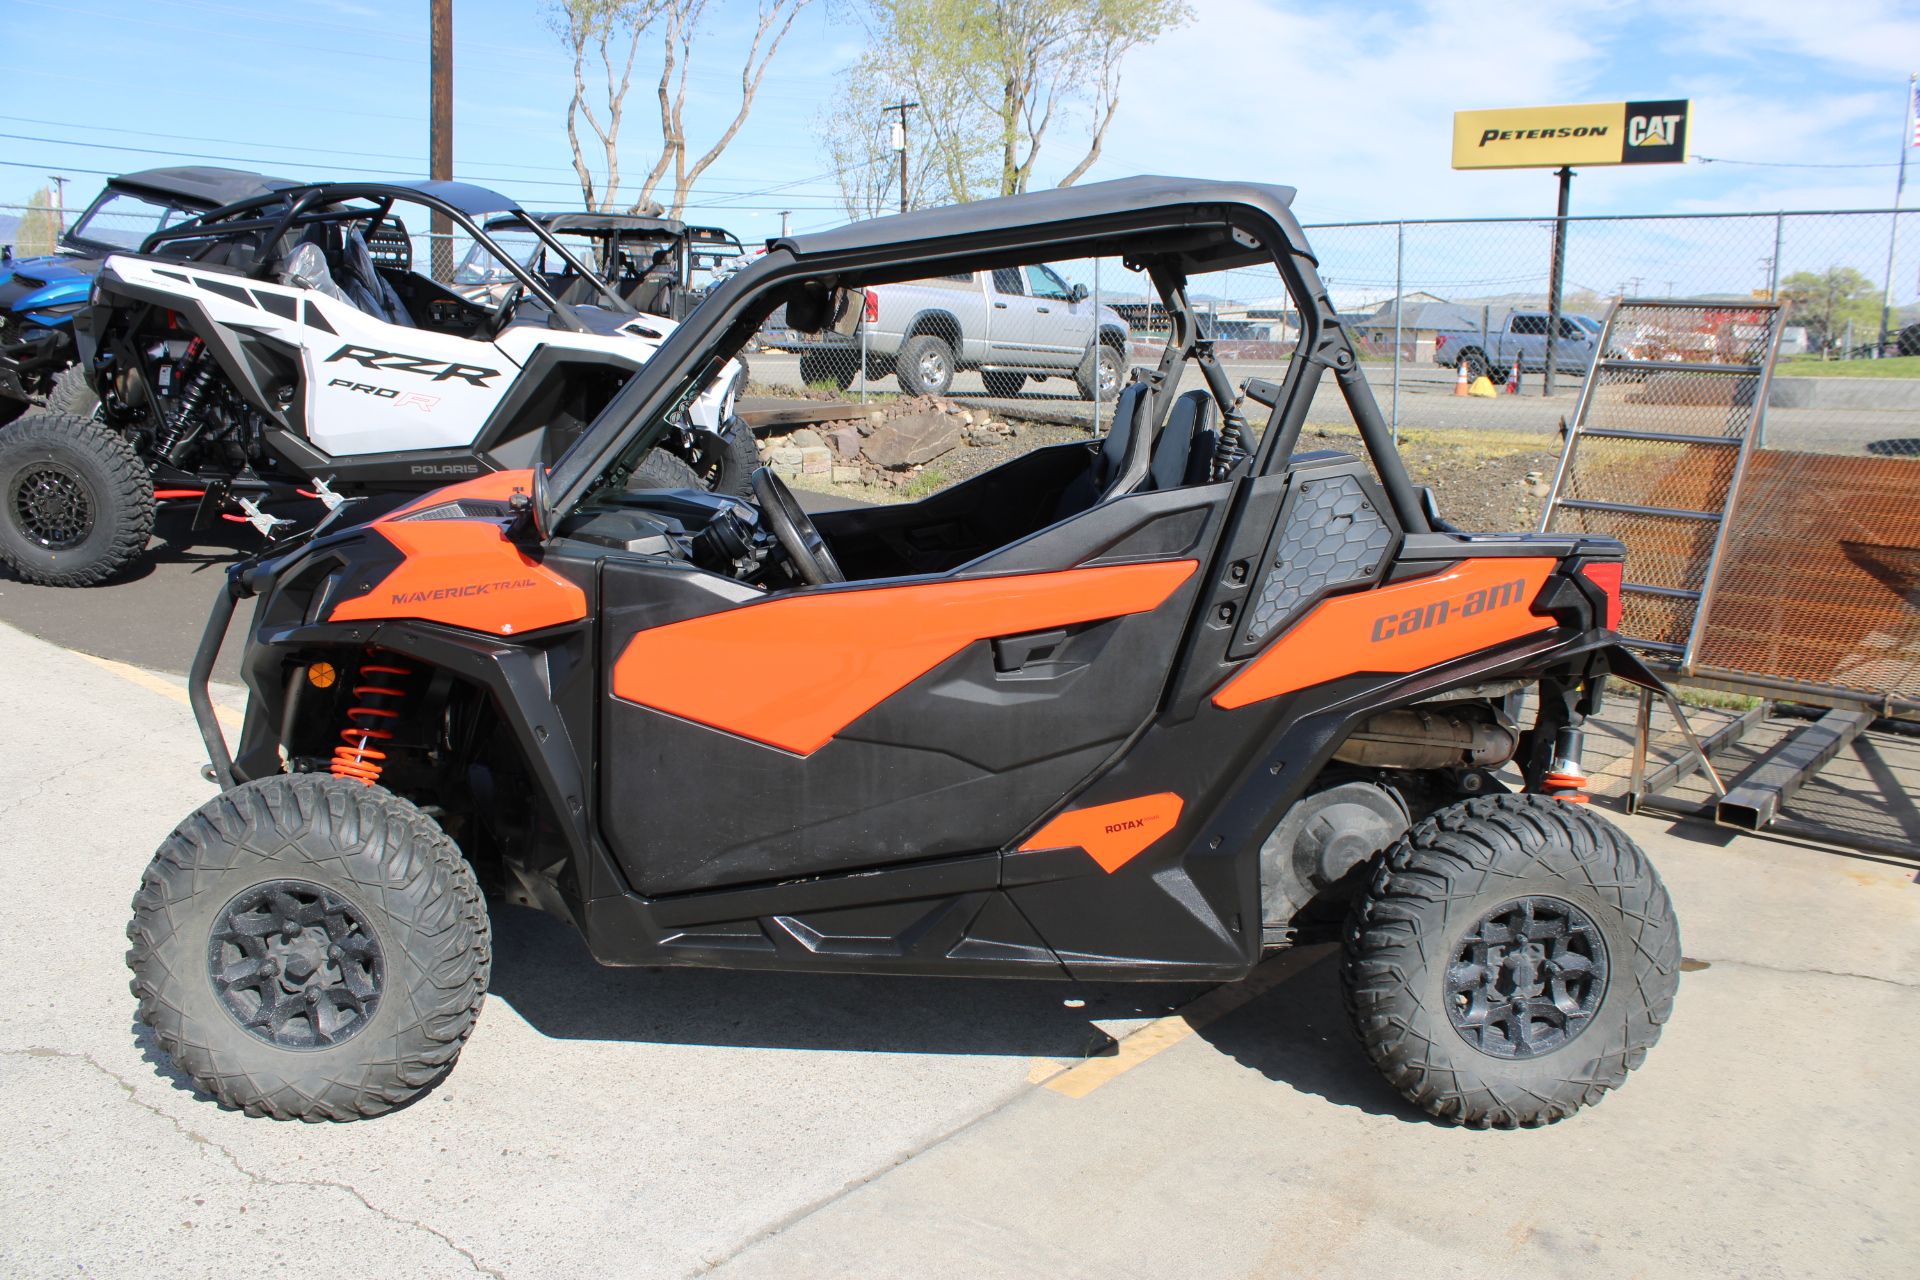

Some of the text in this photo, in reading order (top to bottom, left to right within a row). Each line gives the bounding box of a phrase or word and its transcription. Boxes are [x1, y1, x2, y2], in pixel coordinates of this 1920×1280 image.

[1628, 114, 1681, 147] CAT
[323, 343, 502, 388] RZR
[327, 378, 401, 399] PRO
[410, 464, 479, 475] POLARIS
[391, 578, 537, 605] MAVERICK TRAIL
[1105, 818, 1145, 834] ROTAX
